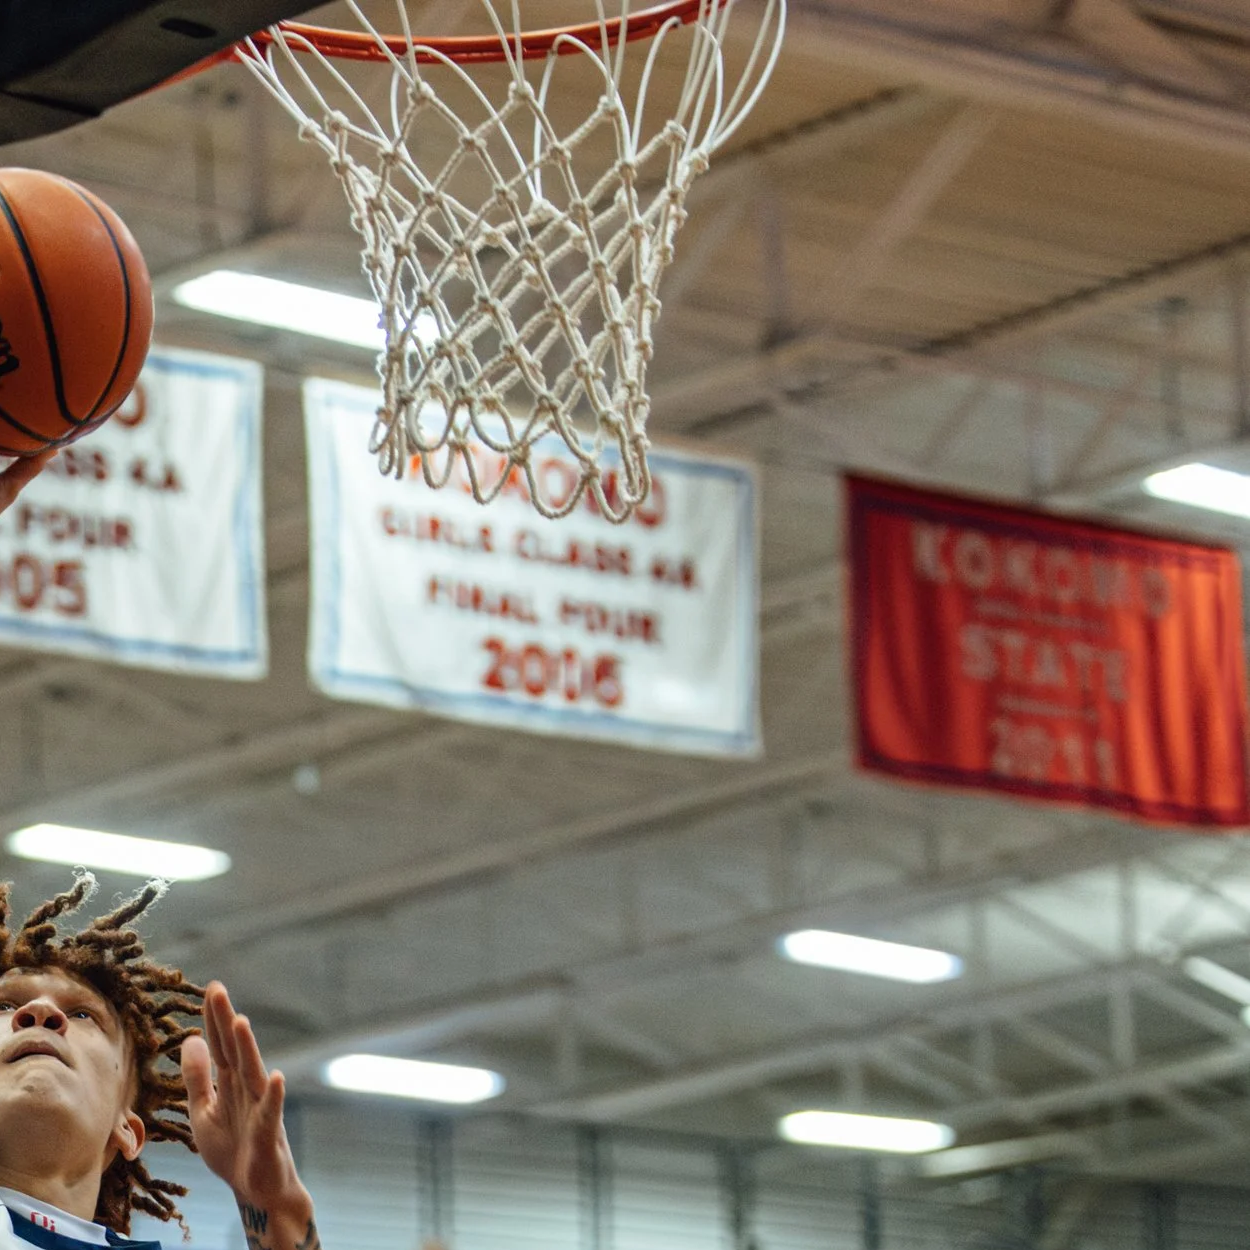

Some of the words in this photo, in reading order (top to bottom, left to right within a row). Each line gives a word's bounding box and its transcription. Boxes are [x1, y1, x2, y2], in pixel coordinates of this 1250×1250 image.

[17, 502, 134, 551] FOUR
[382, 507, 492, 553] GIRLS
[516, 530, 632, 577] CLASS
[914, 522, 1170, 621] KOKOMO
[428, 574, 537, 624] FINAL
[561, 600, 659, 645] FOUR
[482, 636, 623, 708] 2016
[961, 624, 1127, 703] STATE
